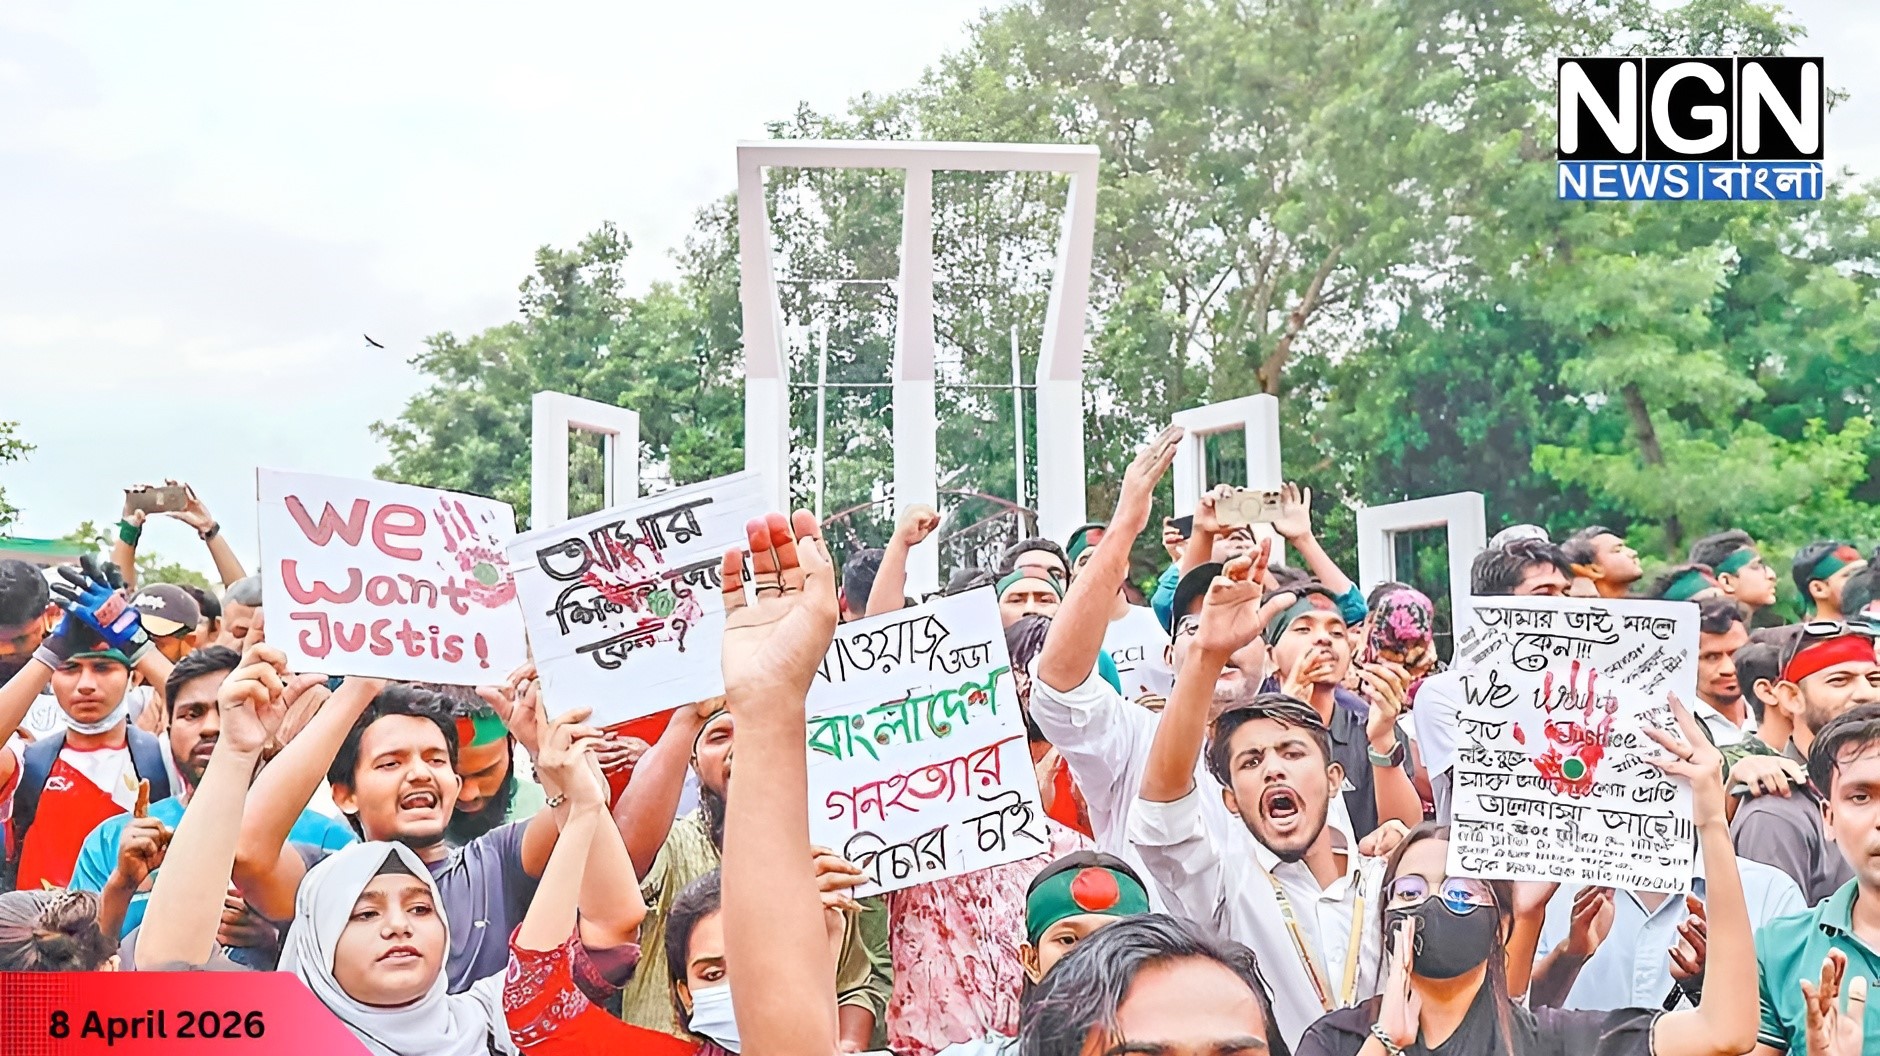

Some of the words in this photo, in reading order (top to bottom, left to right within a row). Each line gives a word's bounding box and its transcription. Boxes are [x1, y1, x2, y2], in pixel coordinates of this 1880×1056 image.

[536, 497, 713, 582] আমার
[1473, 607, 1558, 630] আমার
[1563, 607, 1614, 633] ভাই
[1459, 669, 1520, 709] We
[808, 666, 1010, 761] বাংলাদেশ
[1476, 794, 1591, 821] ভালোবাসা
